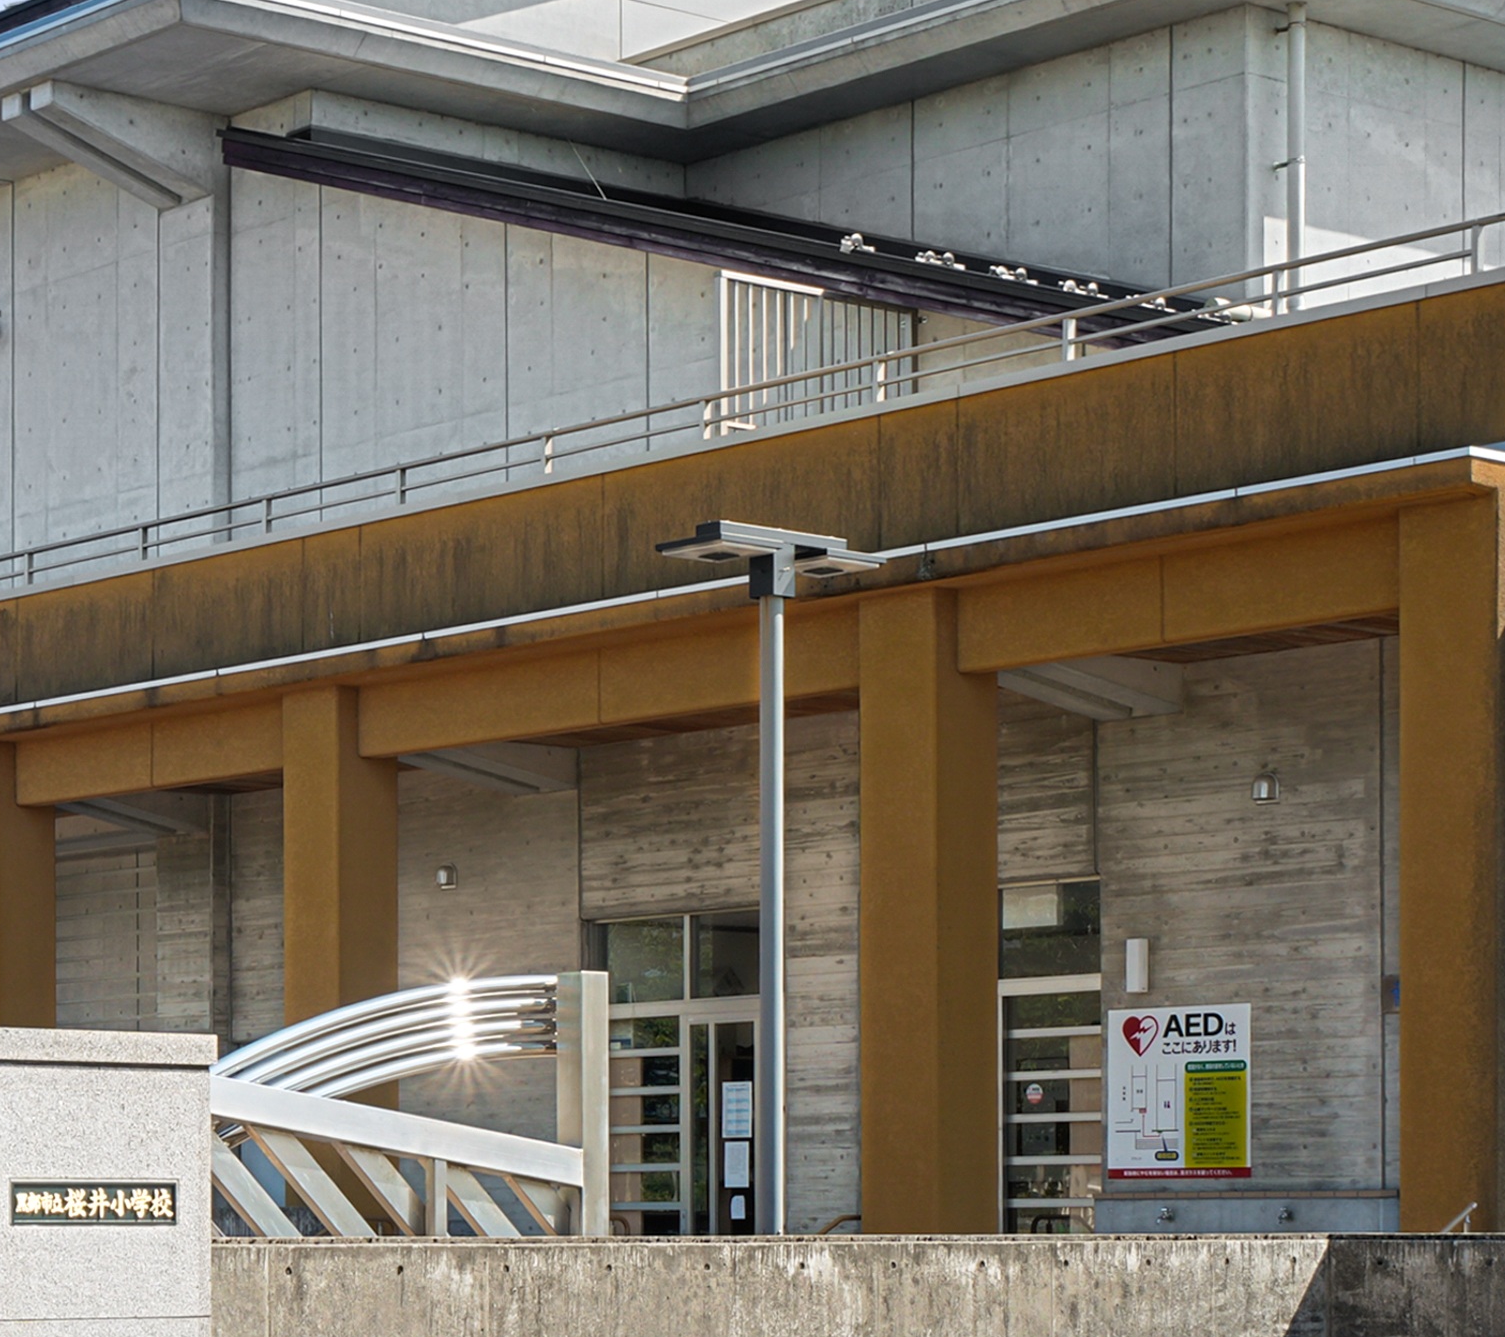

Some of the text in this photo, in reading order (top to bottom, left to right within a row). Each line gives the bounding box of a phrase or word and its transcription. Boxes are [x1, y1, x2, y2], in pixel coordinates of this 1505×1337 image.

[1162, 1013, 1236, 1038] AEDは
[1162, 1039, 1236, 1054] ここにあります!
